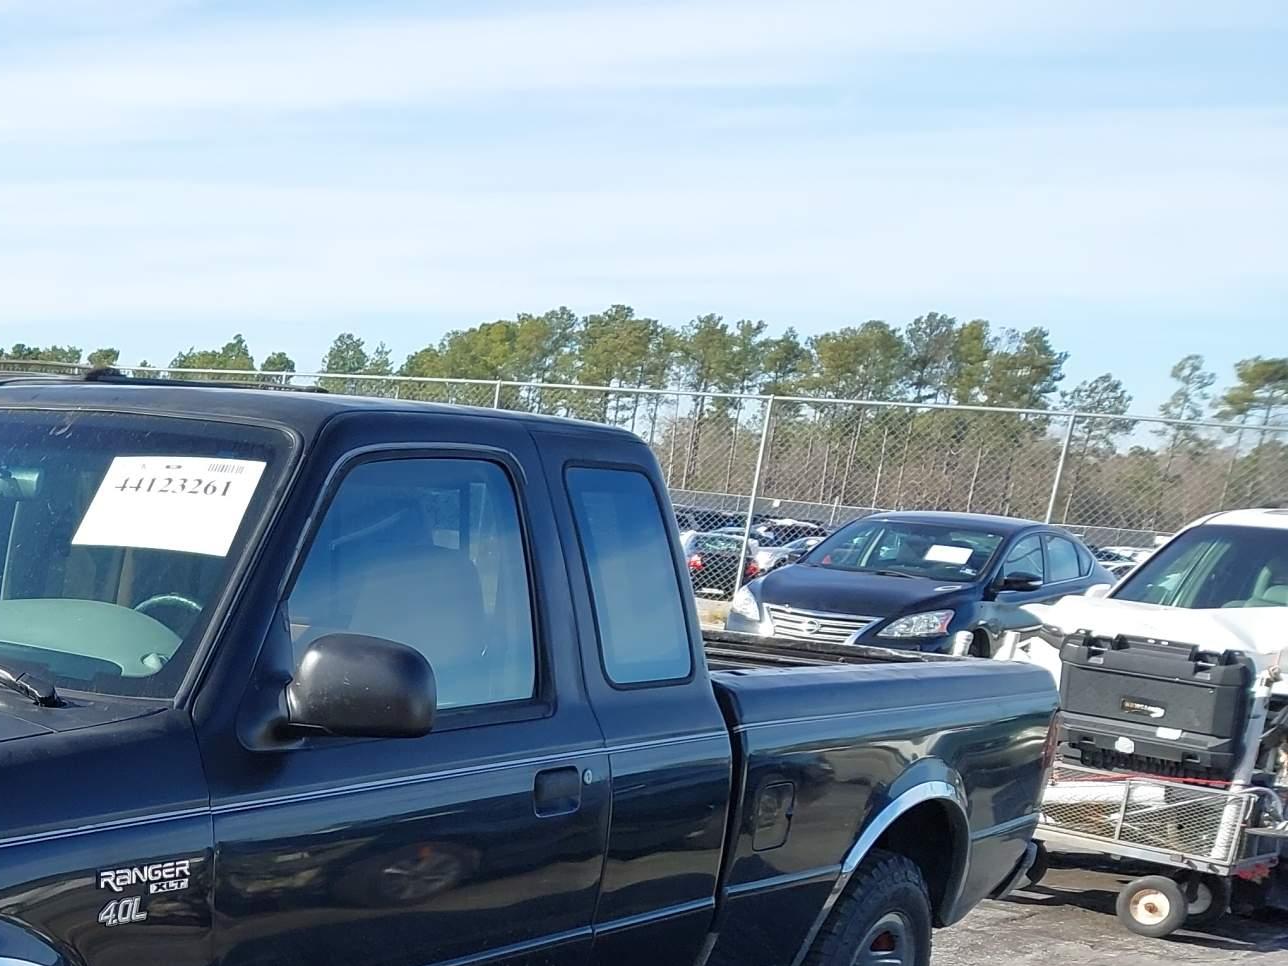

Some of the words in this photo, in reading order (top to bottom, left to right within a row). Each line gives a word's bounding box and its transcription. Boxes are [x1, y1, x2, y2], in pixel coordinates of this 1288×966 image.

[114, 476, 233, 497] 44123261
[152, 878, 187, 893] XLT
[98, 896, 148, 927] 4.0L
